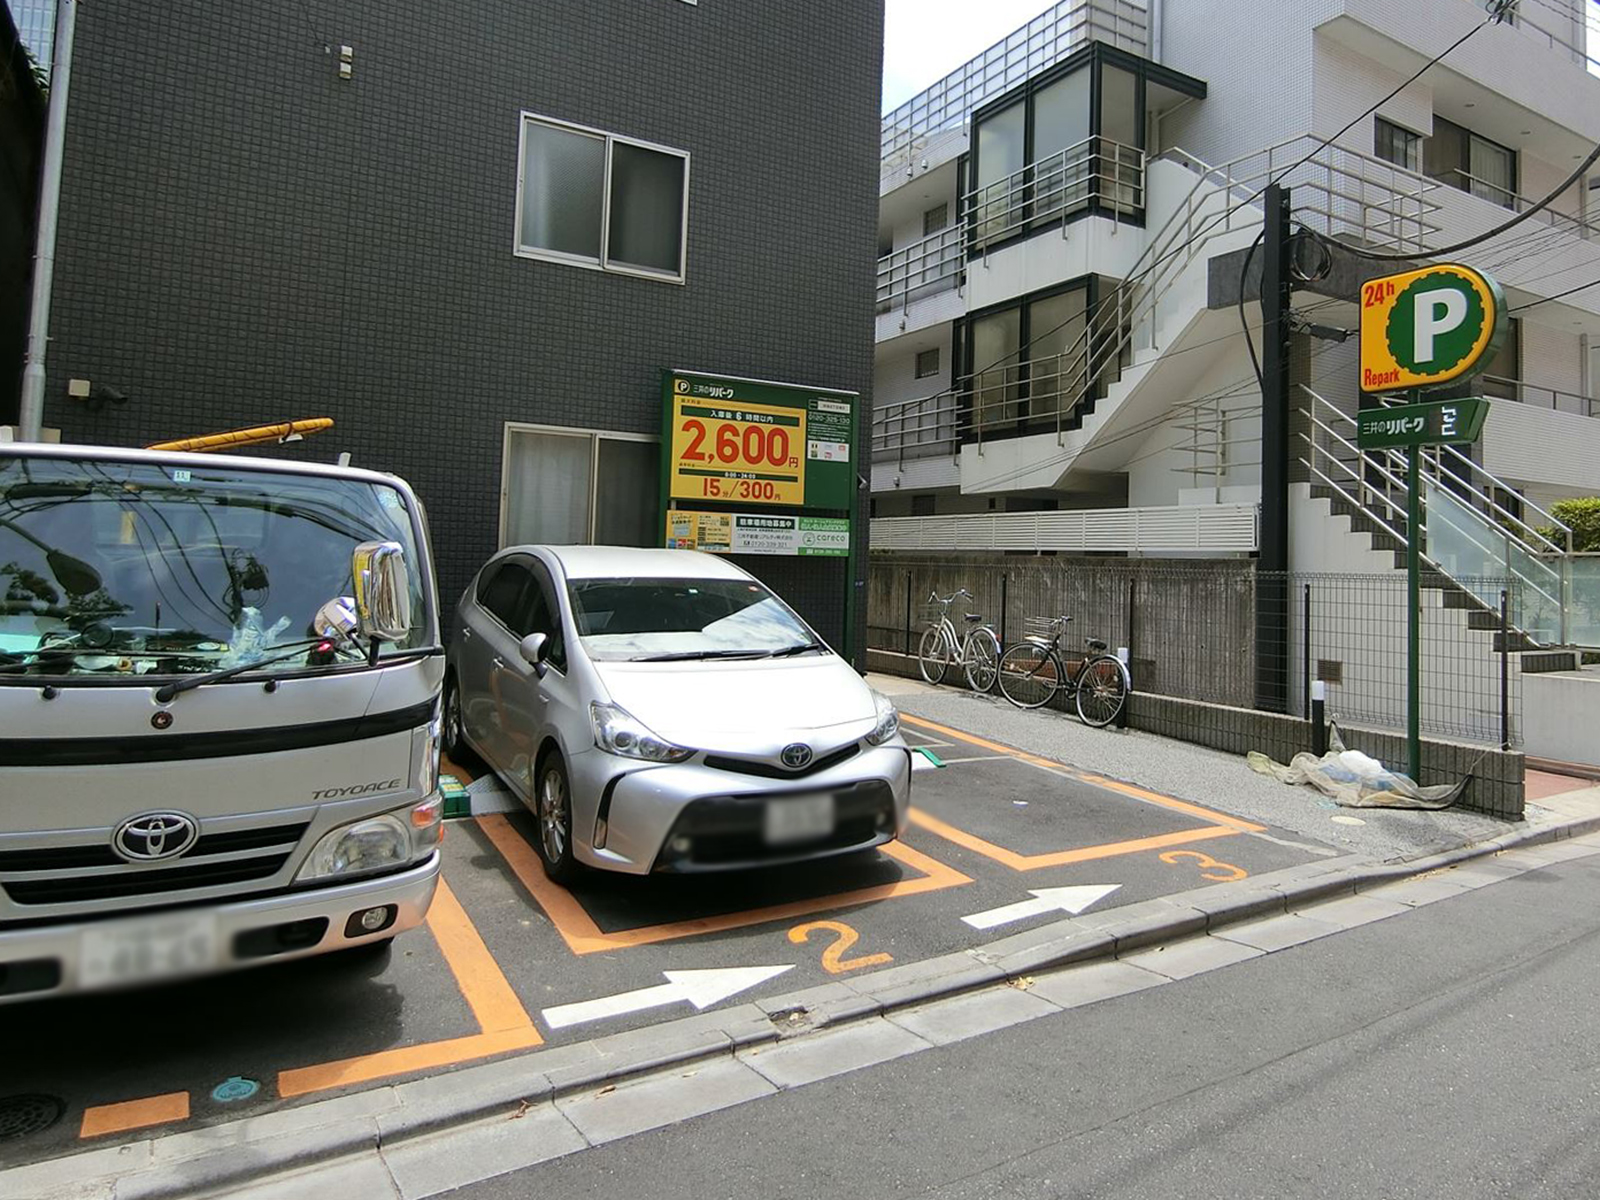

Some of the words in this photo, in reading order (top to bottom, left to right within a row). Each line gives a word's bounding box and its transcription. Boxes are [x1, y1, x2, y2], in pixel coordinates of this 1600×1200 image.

[1365, 282, 1394, 308] 24h
[1413, 287, 1468, 363] P
[1364, 368, 1400, 387] Repark
[1363, 417, 1425, 435] 三井のリパーク
[816, 534, 846, 542] careco
[312, 778, 401, 800] TOYOACE
[1158, 850, 1248, 882] 3
[787, 920, 894, 975] 2
